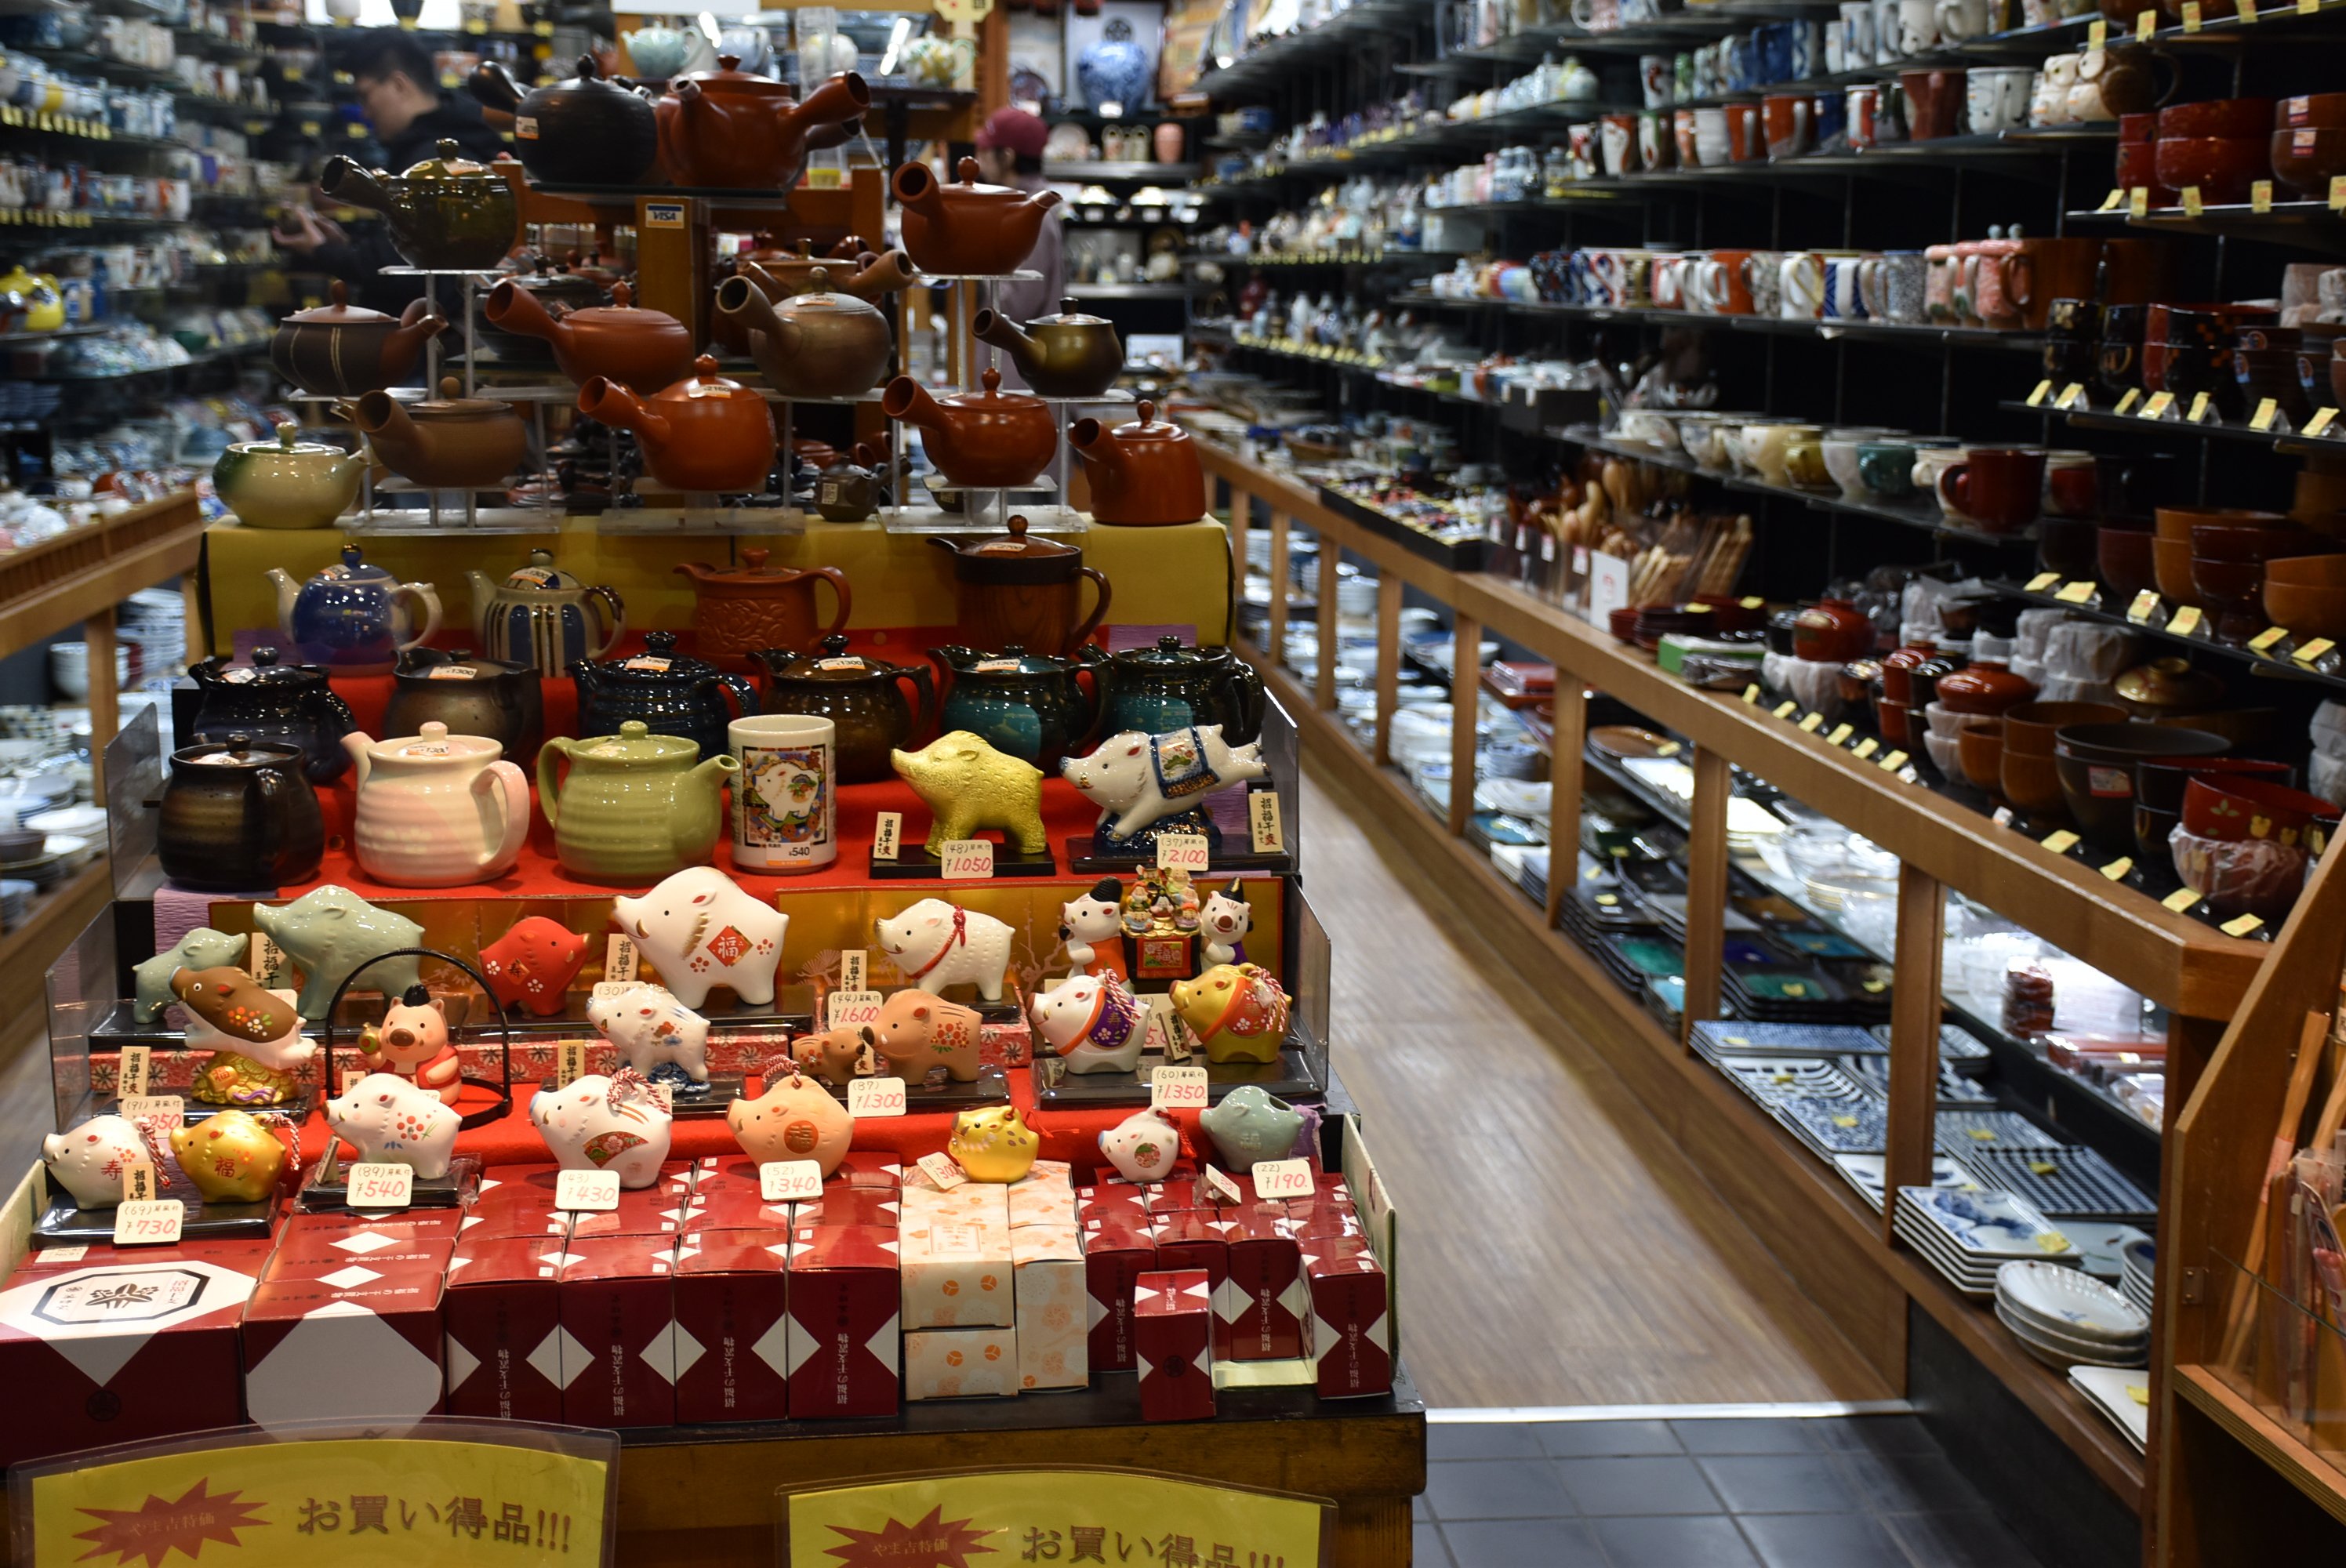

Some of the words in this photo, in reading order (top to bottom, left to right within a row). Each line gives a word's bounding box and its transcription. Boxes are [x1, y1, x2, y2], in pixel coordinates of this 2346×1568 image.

[652, 212, 676, 221] VISA
[1161, 838, 1183, 848] (37)
[789, 846, 810, 856] ¥540
[717, 936, 739, 960] 福
[263, 939, 280, 989] 招福干
[1157, 1069, 1179, 1080] (60)
[852, 1080, 880, 1091] (87)
[126, 1101, 148, 1110] (91)
[790, 1124, 813, 1149] 福
[100, 1159, 123, 1181] 寿
[214, 1156, 235, 1178] 福
[358, 1166, 385, 1178] (89)
[766, 1166, 794, 1176] (52)
[562, 1172, 590, 1184] (43)
[125, 1206, 152, 1215] (69)
[872, 1537, 949, 1558] やま吉特価
